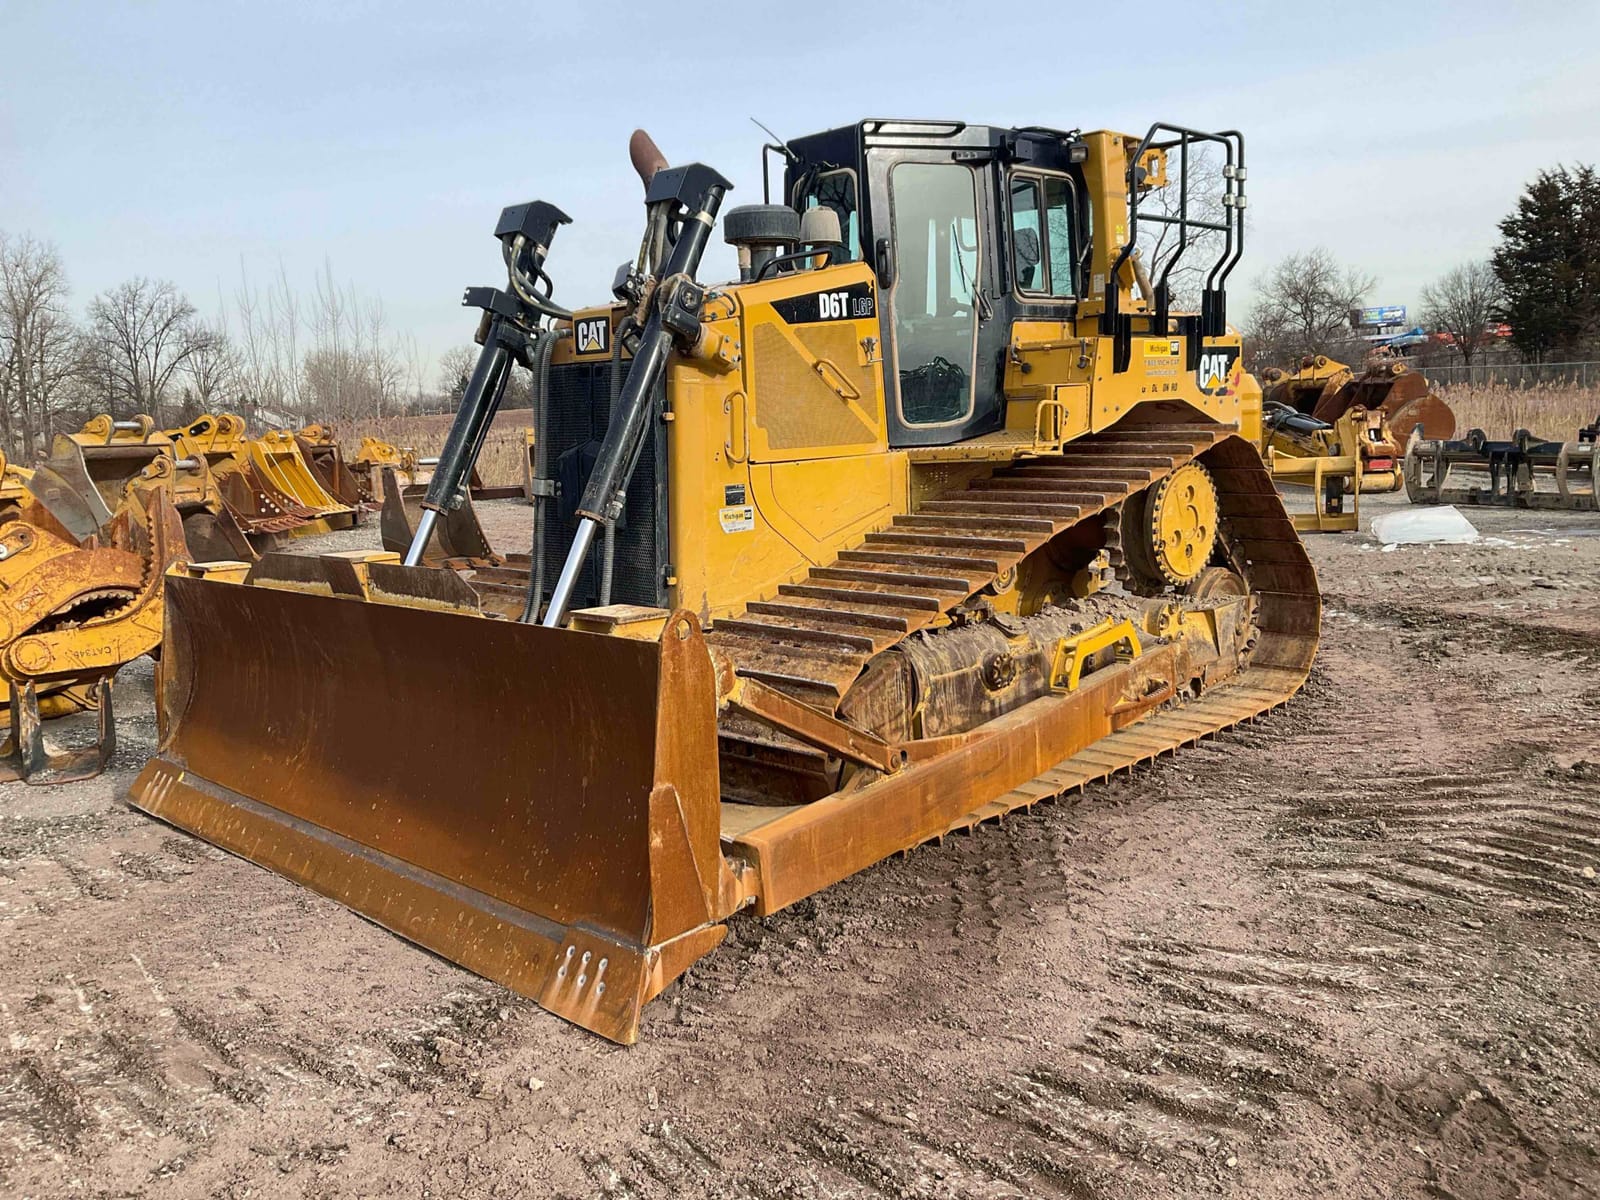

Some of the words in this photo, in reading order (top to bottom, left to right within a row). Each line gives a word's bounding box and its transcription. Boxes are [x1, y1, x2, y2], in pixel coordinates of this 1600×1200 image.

[819, 292, 848, 318] D6T
[852, 298, 873, 316] LGP
[578, 320, 606, 351] CAT
[1200, 354, 1228, 389] CAT
